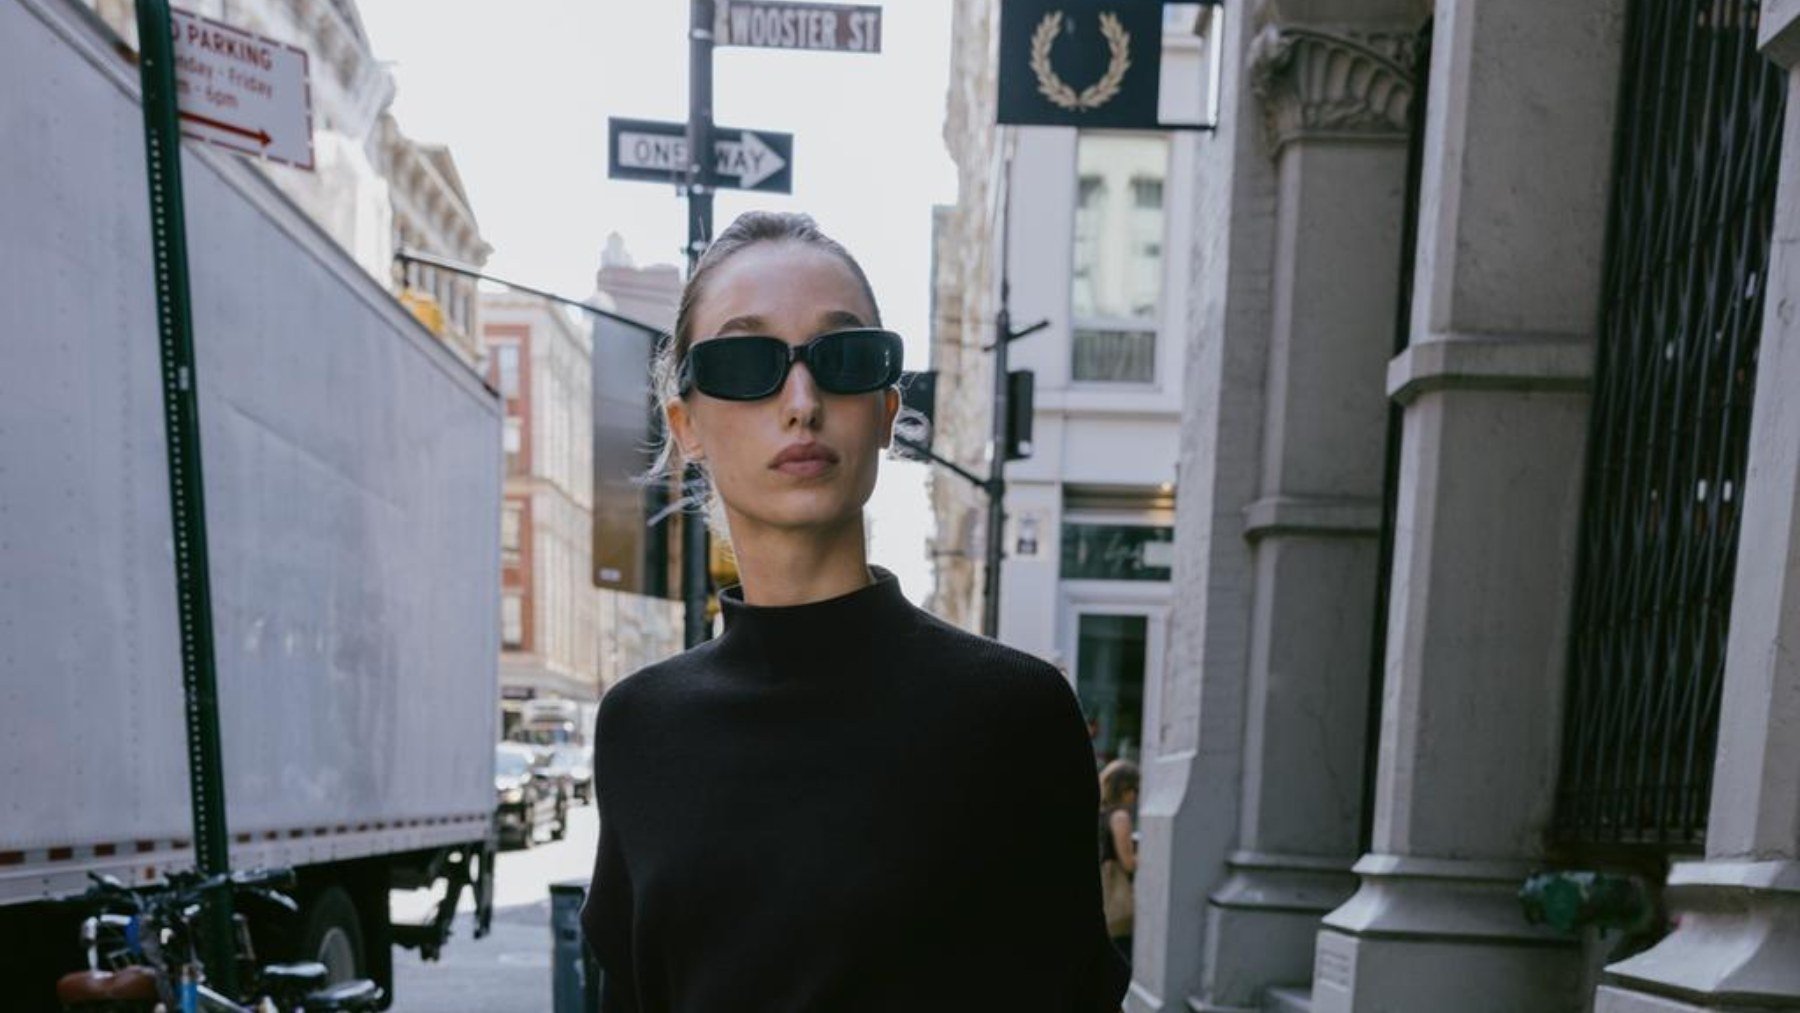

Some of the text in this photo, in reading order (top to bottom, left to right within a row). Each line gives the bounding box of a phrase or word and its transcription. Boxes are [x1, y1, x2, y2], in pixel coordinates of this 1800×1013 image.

[187, 24, 274, 71] PARKING
[731, 4, 879, 52] WOOSTER ST
[230, 67, 273, 99] Friday
[634, 140, 767, 174] ONE WAY
